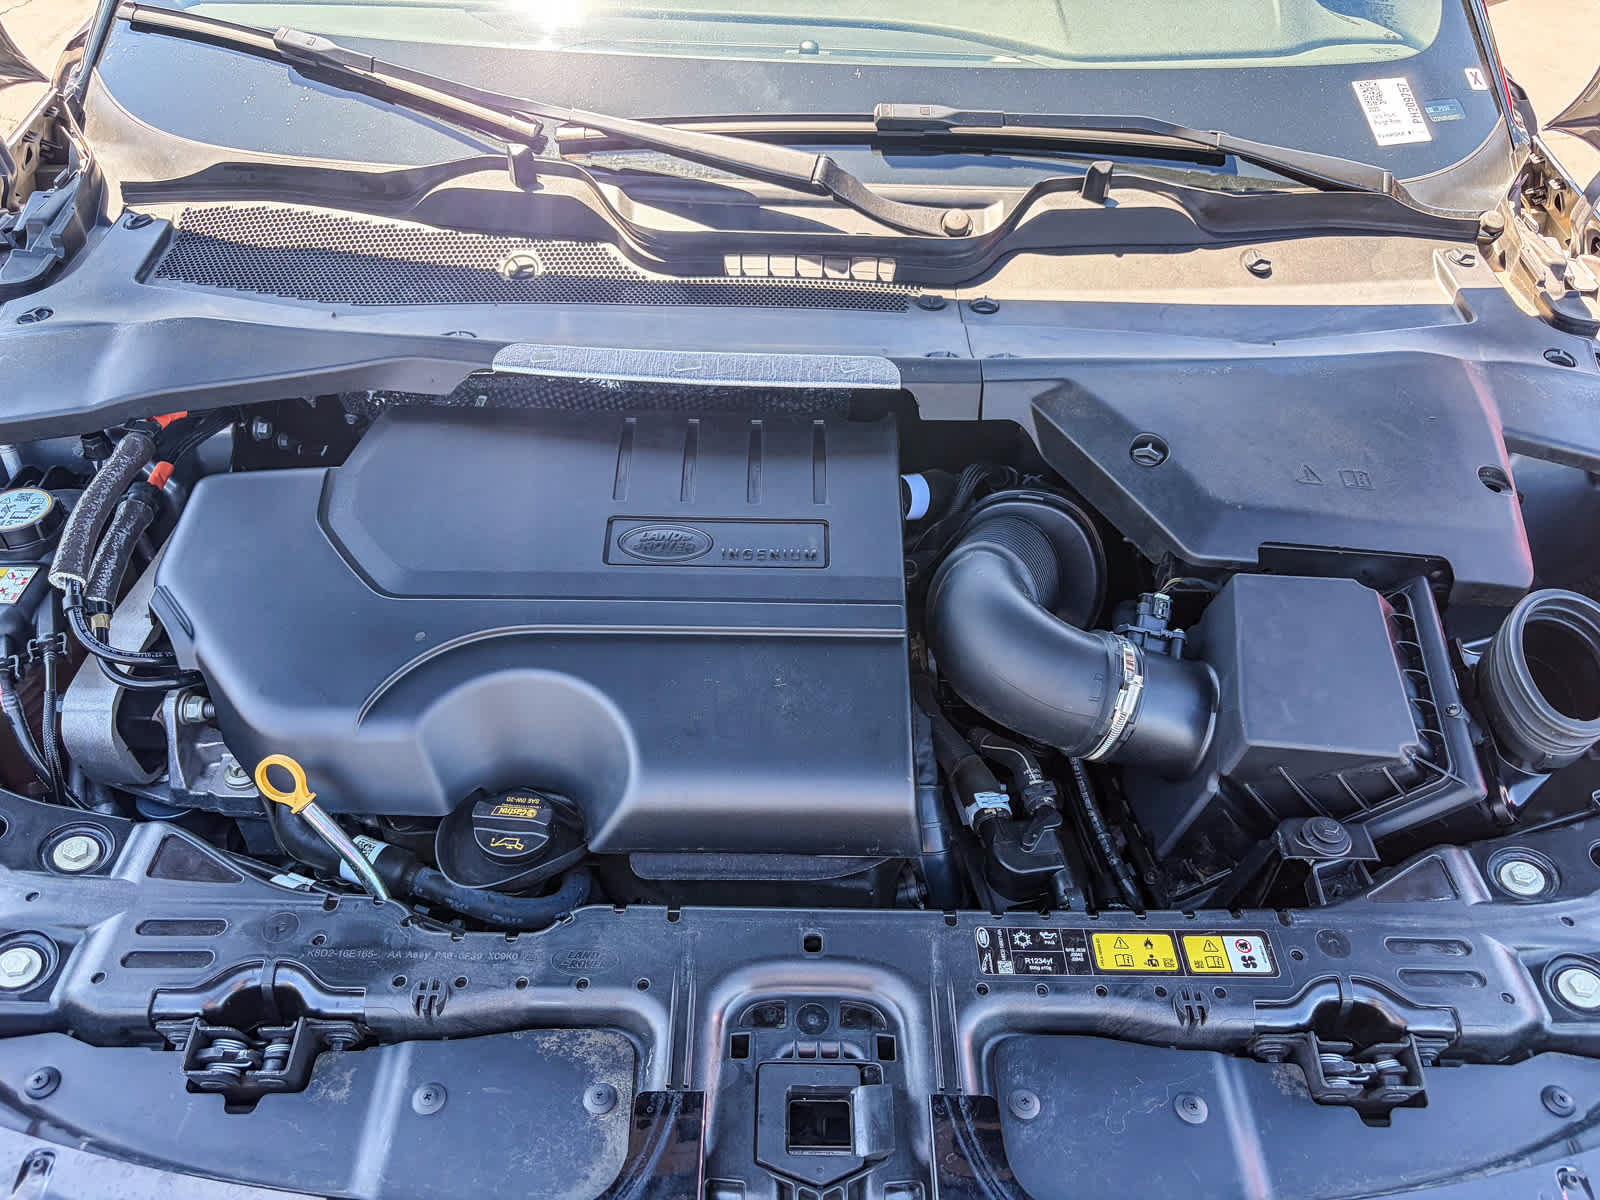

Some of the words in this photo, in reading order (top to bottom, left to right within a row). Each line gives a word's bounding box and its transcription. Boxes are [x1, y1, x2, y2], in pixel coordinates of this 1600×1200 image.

[1469, 71, 1482, 85] X
[721, 547, 818, 562] INGENIUM
[499, 807, 528, 816] Castrol
[1024, 957, 1054, 966] R1234yf
